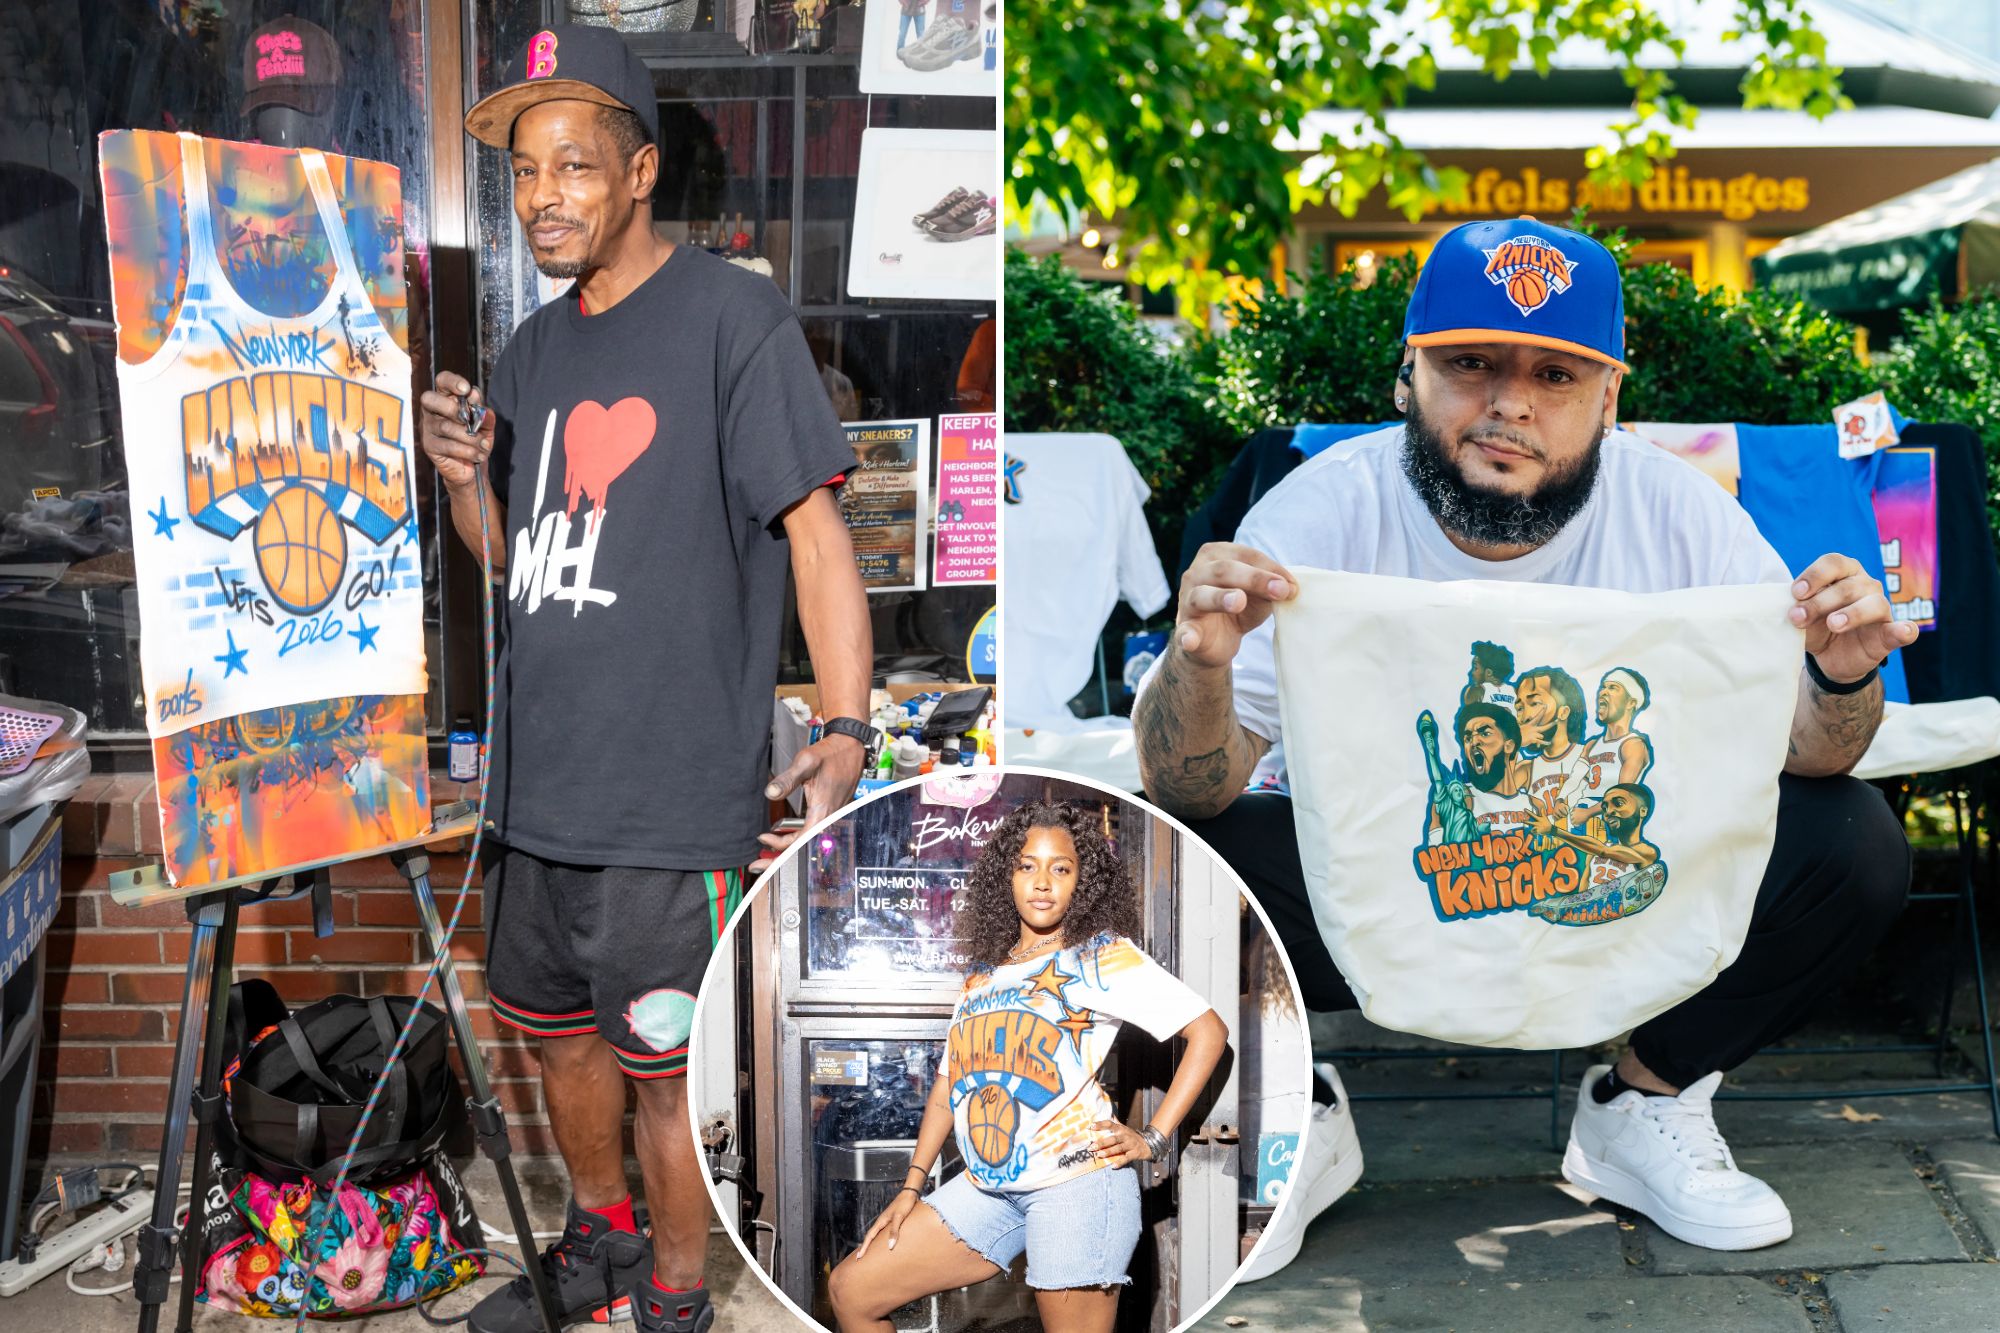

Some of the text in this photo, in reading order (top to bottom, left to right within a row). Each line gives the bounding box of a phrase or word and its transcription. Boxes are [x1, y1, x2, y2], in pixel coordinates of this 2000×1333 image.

[527, 30, 558, 80] B
[1638, 165, 1810, 221] dinges
[1487, 242, 1571, 286] KNICKS
[944, 417, 981, 430] KEEP
[860, 428, 913, 441] SNEAKERS?
[181, 371, 409, 523] KNICKS
[972, 438, 996, 451] HA
[950, 474, 970, 483] HAS
[950, 486, 992, 495] HARLEM,
[971, 498, 996, 506] NEIG
[937, 523, 954, 532] GET
[948, 535, 971, 543] TALK
[974, 534, 986, 542] TO
[949, 558, 970, 566] JOIN
[946, 569, 985, 578] GROUPS
[276, 610, 342, 657] 2026
[1589, 764, 1601, 790] 3
[1592, 866, 1618, 885] 25
[981, 1086, 998, 1109] 26
